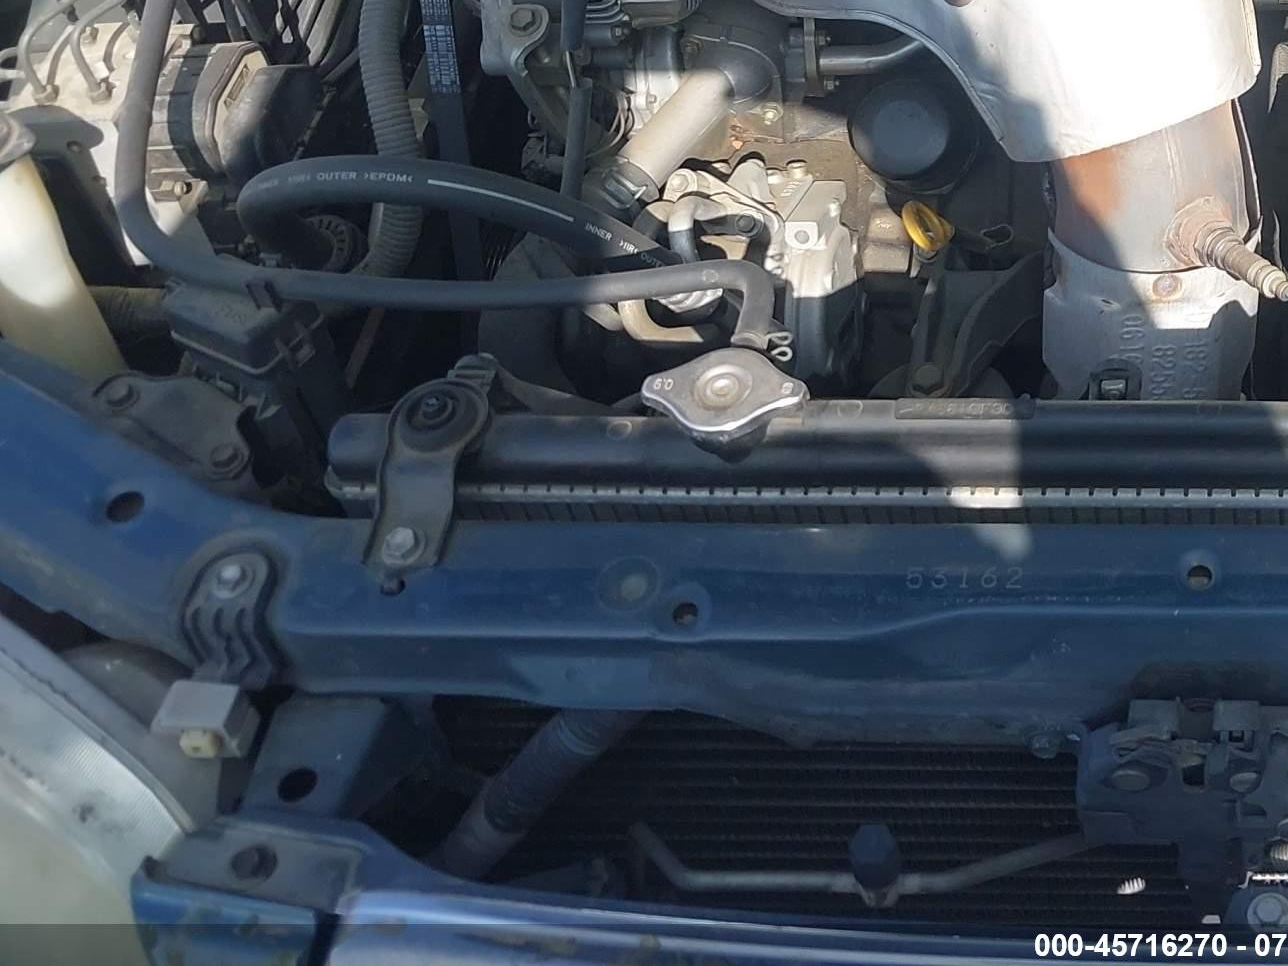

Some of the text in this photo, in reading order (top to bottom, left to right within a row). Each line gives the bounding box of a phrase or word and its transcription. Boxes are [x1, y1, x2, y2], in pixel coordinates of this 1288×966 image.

[316, 172, 358, 180] OUTER
[585, 222, 613, 241] INNER
[905, 566, 1024, 589] 53162
